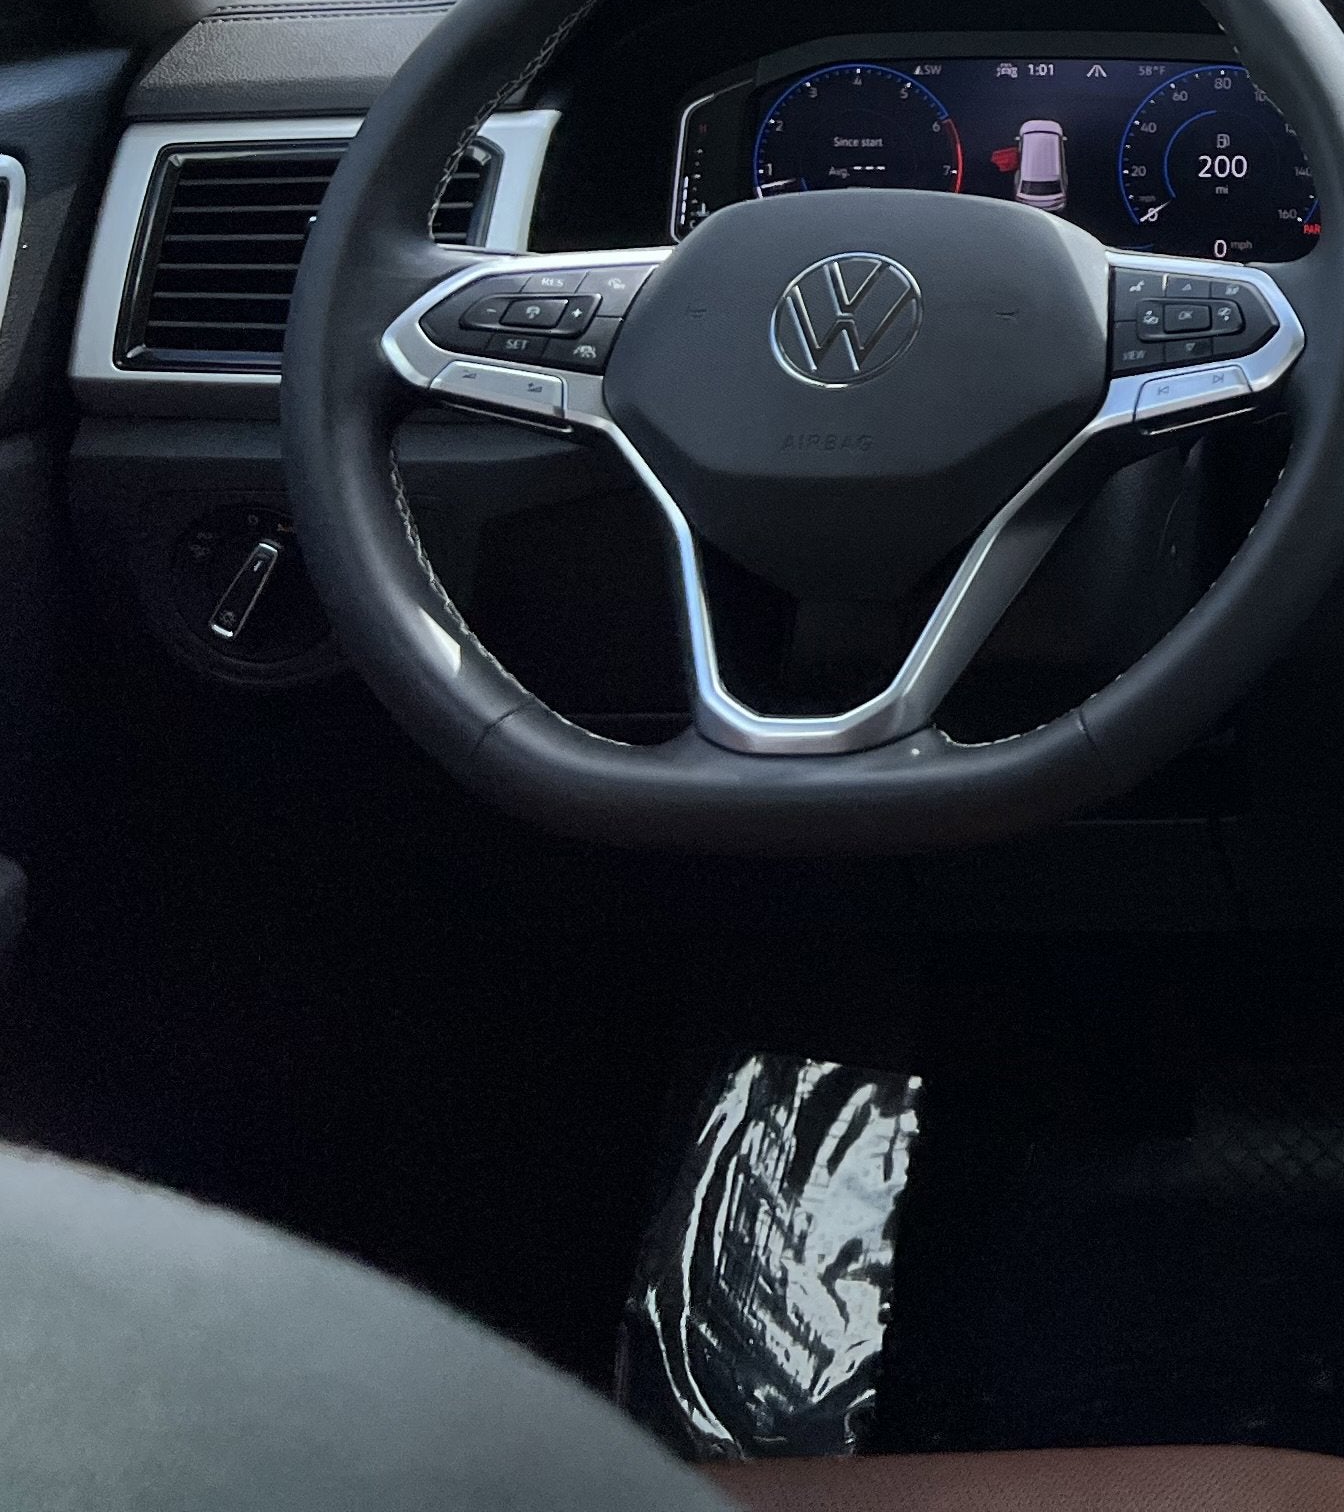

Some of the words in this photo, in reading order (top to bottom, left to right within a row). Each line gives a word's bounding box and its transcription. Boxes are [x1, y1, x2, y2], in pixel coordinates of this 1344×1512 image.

[1027, 63, 1055, 76] 1:01
[852, 76, 862, 86] 4
[1214, 77, 1231, 90] 80
[809, 88, 819, 98] 3
[899, 88, 909, 99] 5
[1172, 90, 1188, 101] 60
[774, 121, 784, 132] 2
[932, 121, 941, 133] 6
[1140, 122, 1157, 133] 40
[833, 136, 860, 148] Since
[861, 137, 883, 148] start
[1131, 166, 1147, 177] 20
[1198, 155, 1248, 178] 200
[1215, 185, 1229, 195] mi
[1278, 209, 1298, 219] 160
[1213, 239, 1227, 258] 0
[1230, 240, 1253, 252] mph
[541, 277, 564, 289] RES
[505, 339, 529, 351] SET
